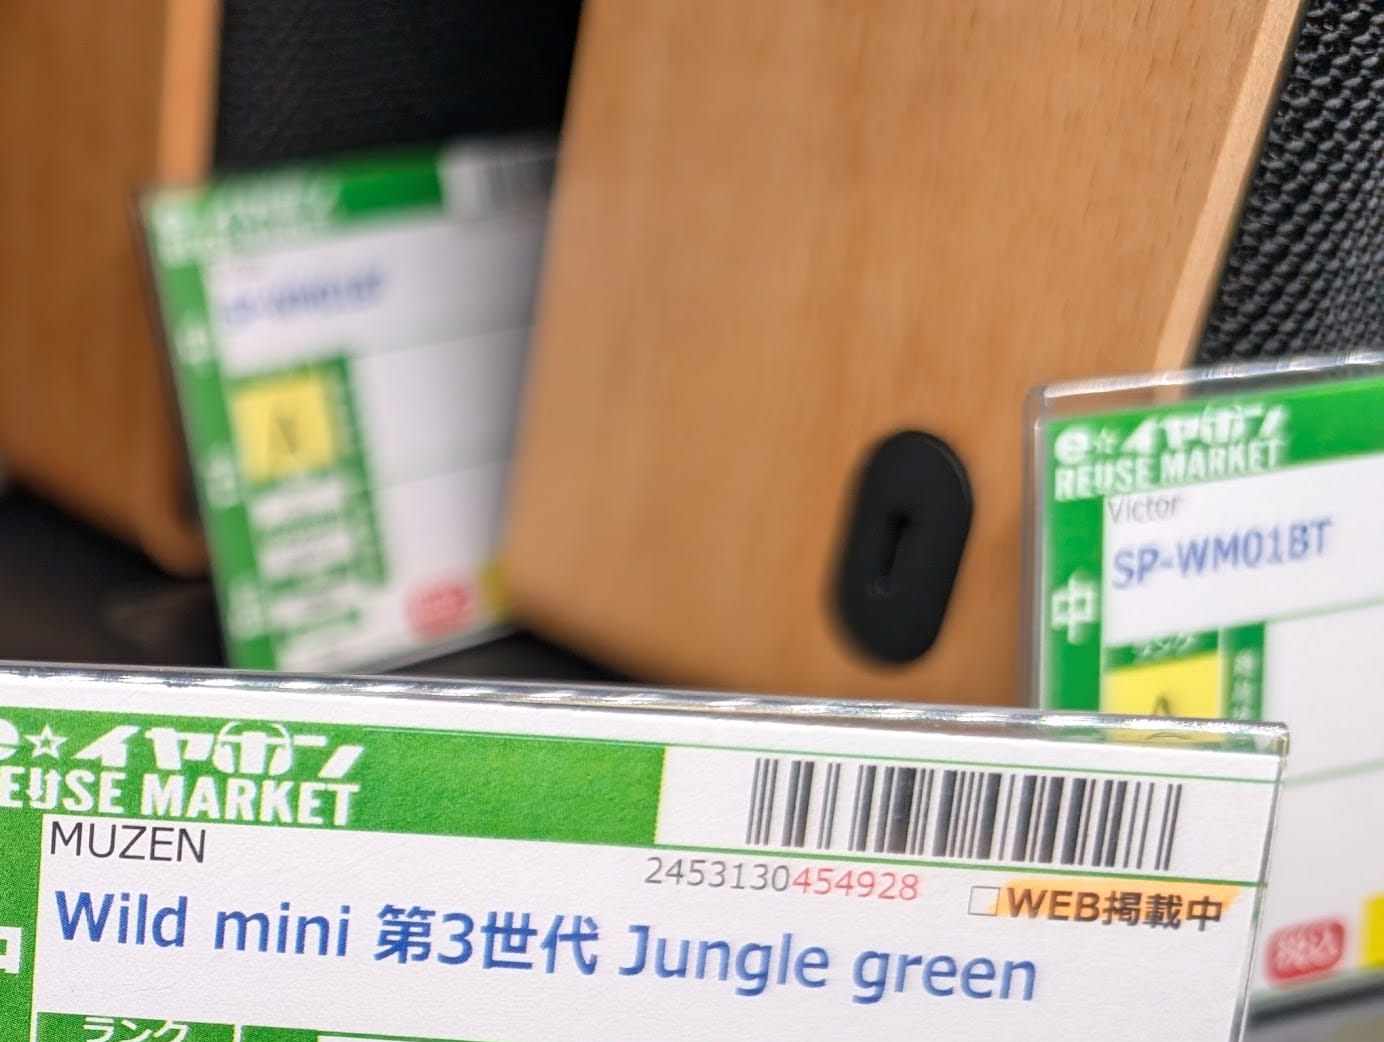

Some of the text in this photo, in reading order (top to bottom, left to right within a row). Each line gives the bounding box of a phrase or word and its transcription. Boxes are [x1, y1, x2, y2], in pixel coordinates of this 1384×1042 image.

[1054, 441, 1284, 501] REUSE MARKET
[1108, 495, 1182, 524] Victor
[1112, 517, 1333, 588] SP-WM01BT
[142, 774, 360, 826] MARKET
[50, 820, 206, 863] MUZEN
[644, 856, 919, 901] 2453130454928
[1006, 886, 1222, 932] WEB掲載中
[54, 890, 1037, 1004] Wild mini 第3世代 Jungle green
